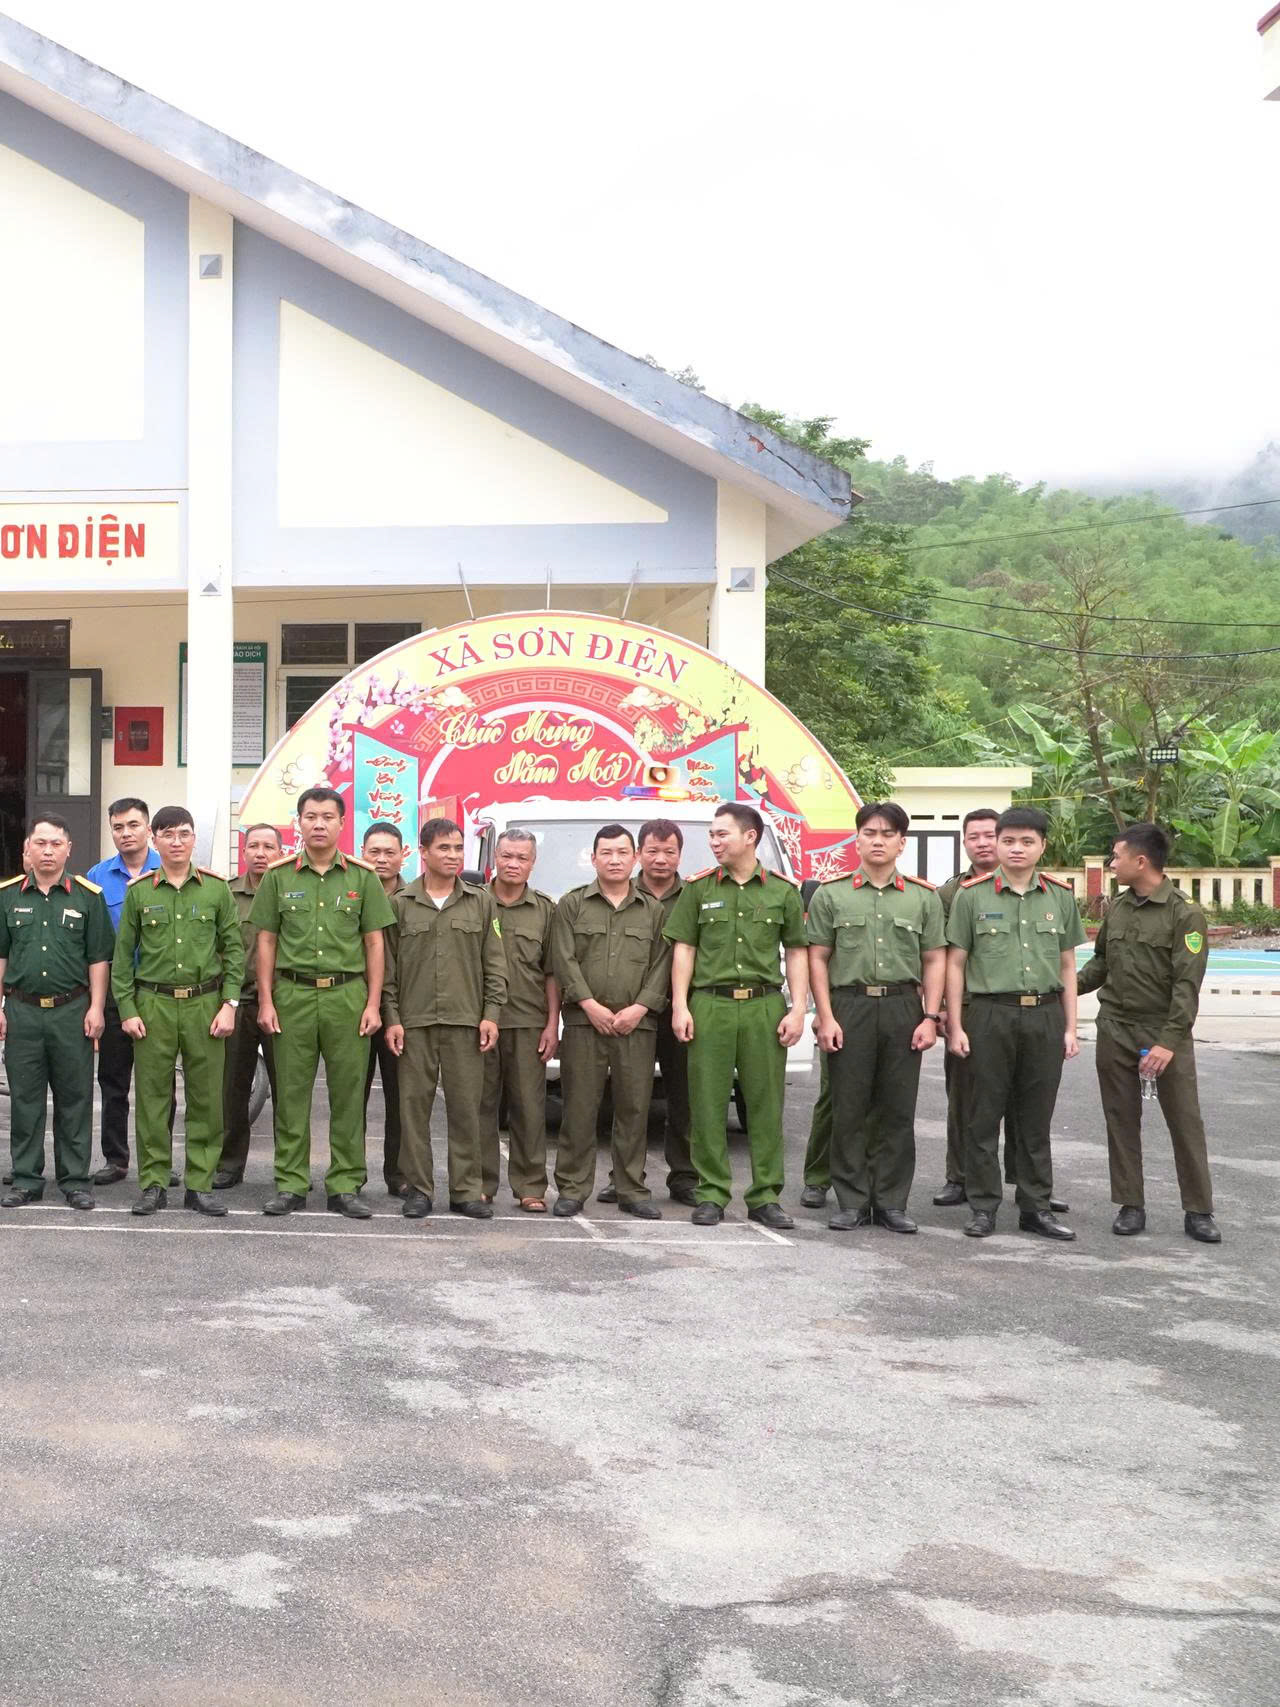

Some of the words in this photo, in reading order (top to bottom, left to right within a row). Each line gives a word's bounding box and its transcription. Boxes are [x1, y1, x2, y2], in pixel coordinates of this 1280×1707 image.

[58, 513, 145, 567] ĐIỆN
[428, 634, 485, 677] XÃ
[492, 627, 575, 660] SƠN
[585, 633, 689, 684] ĐIỆN
[439, 711, 506, 749] Chúc
[511, 711, 595, 751] Mừng
[494, 750, 559, 784] Năm
